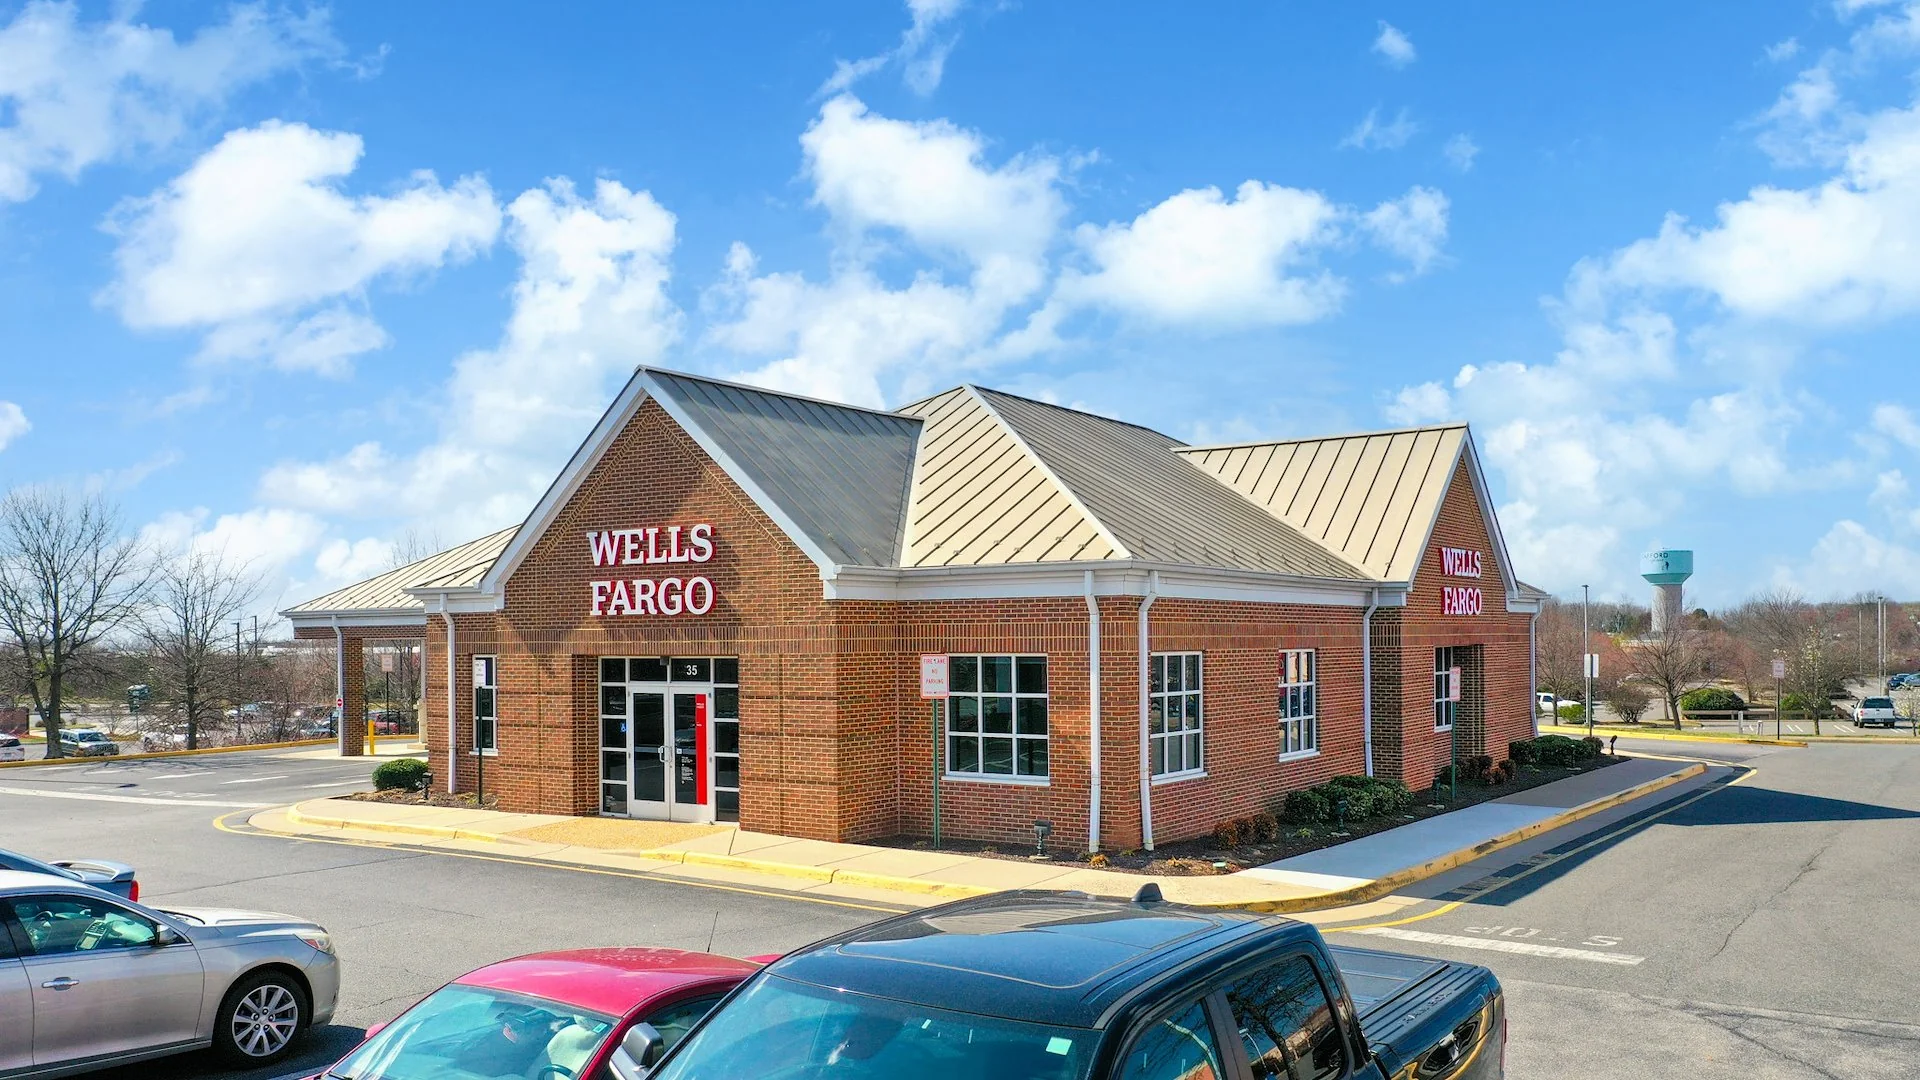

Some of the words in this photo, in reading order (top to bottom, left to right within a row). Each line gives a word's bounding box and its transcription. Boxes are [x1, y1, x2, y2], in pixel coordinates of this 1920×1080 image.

[586, 523, 715, 566] WELLS
[1440, 547, 1482, 579] WELLS
[590, 576, 715, 616] FARGO
[1443, 587, 1482, 616] FARGO
[686, 664, 698, 676] 35
[1463, 925, 1624, 946] SOP
